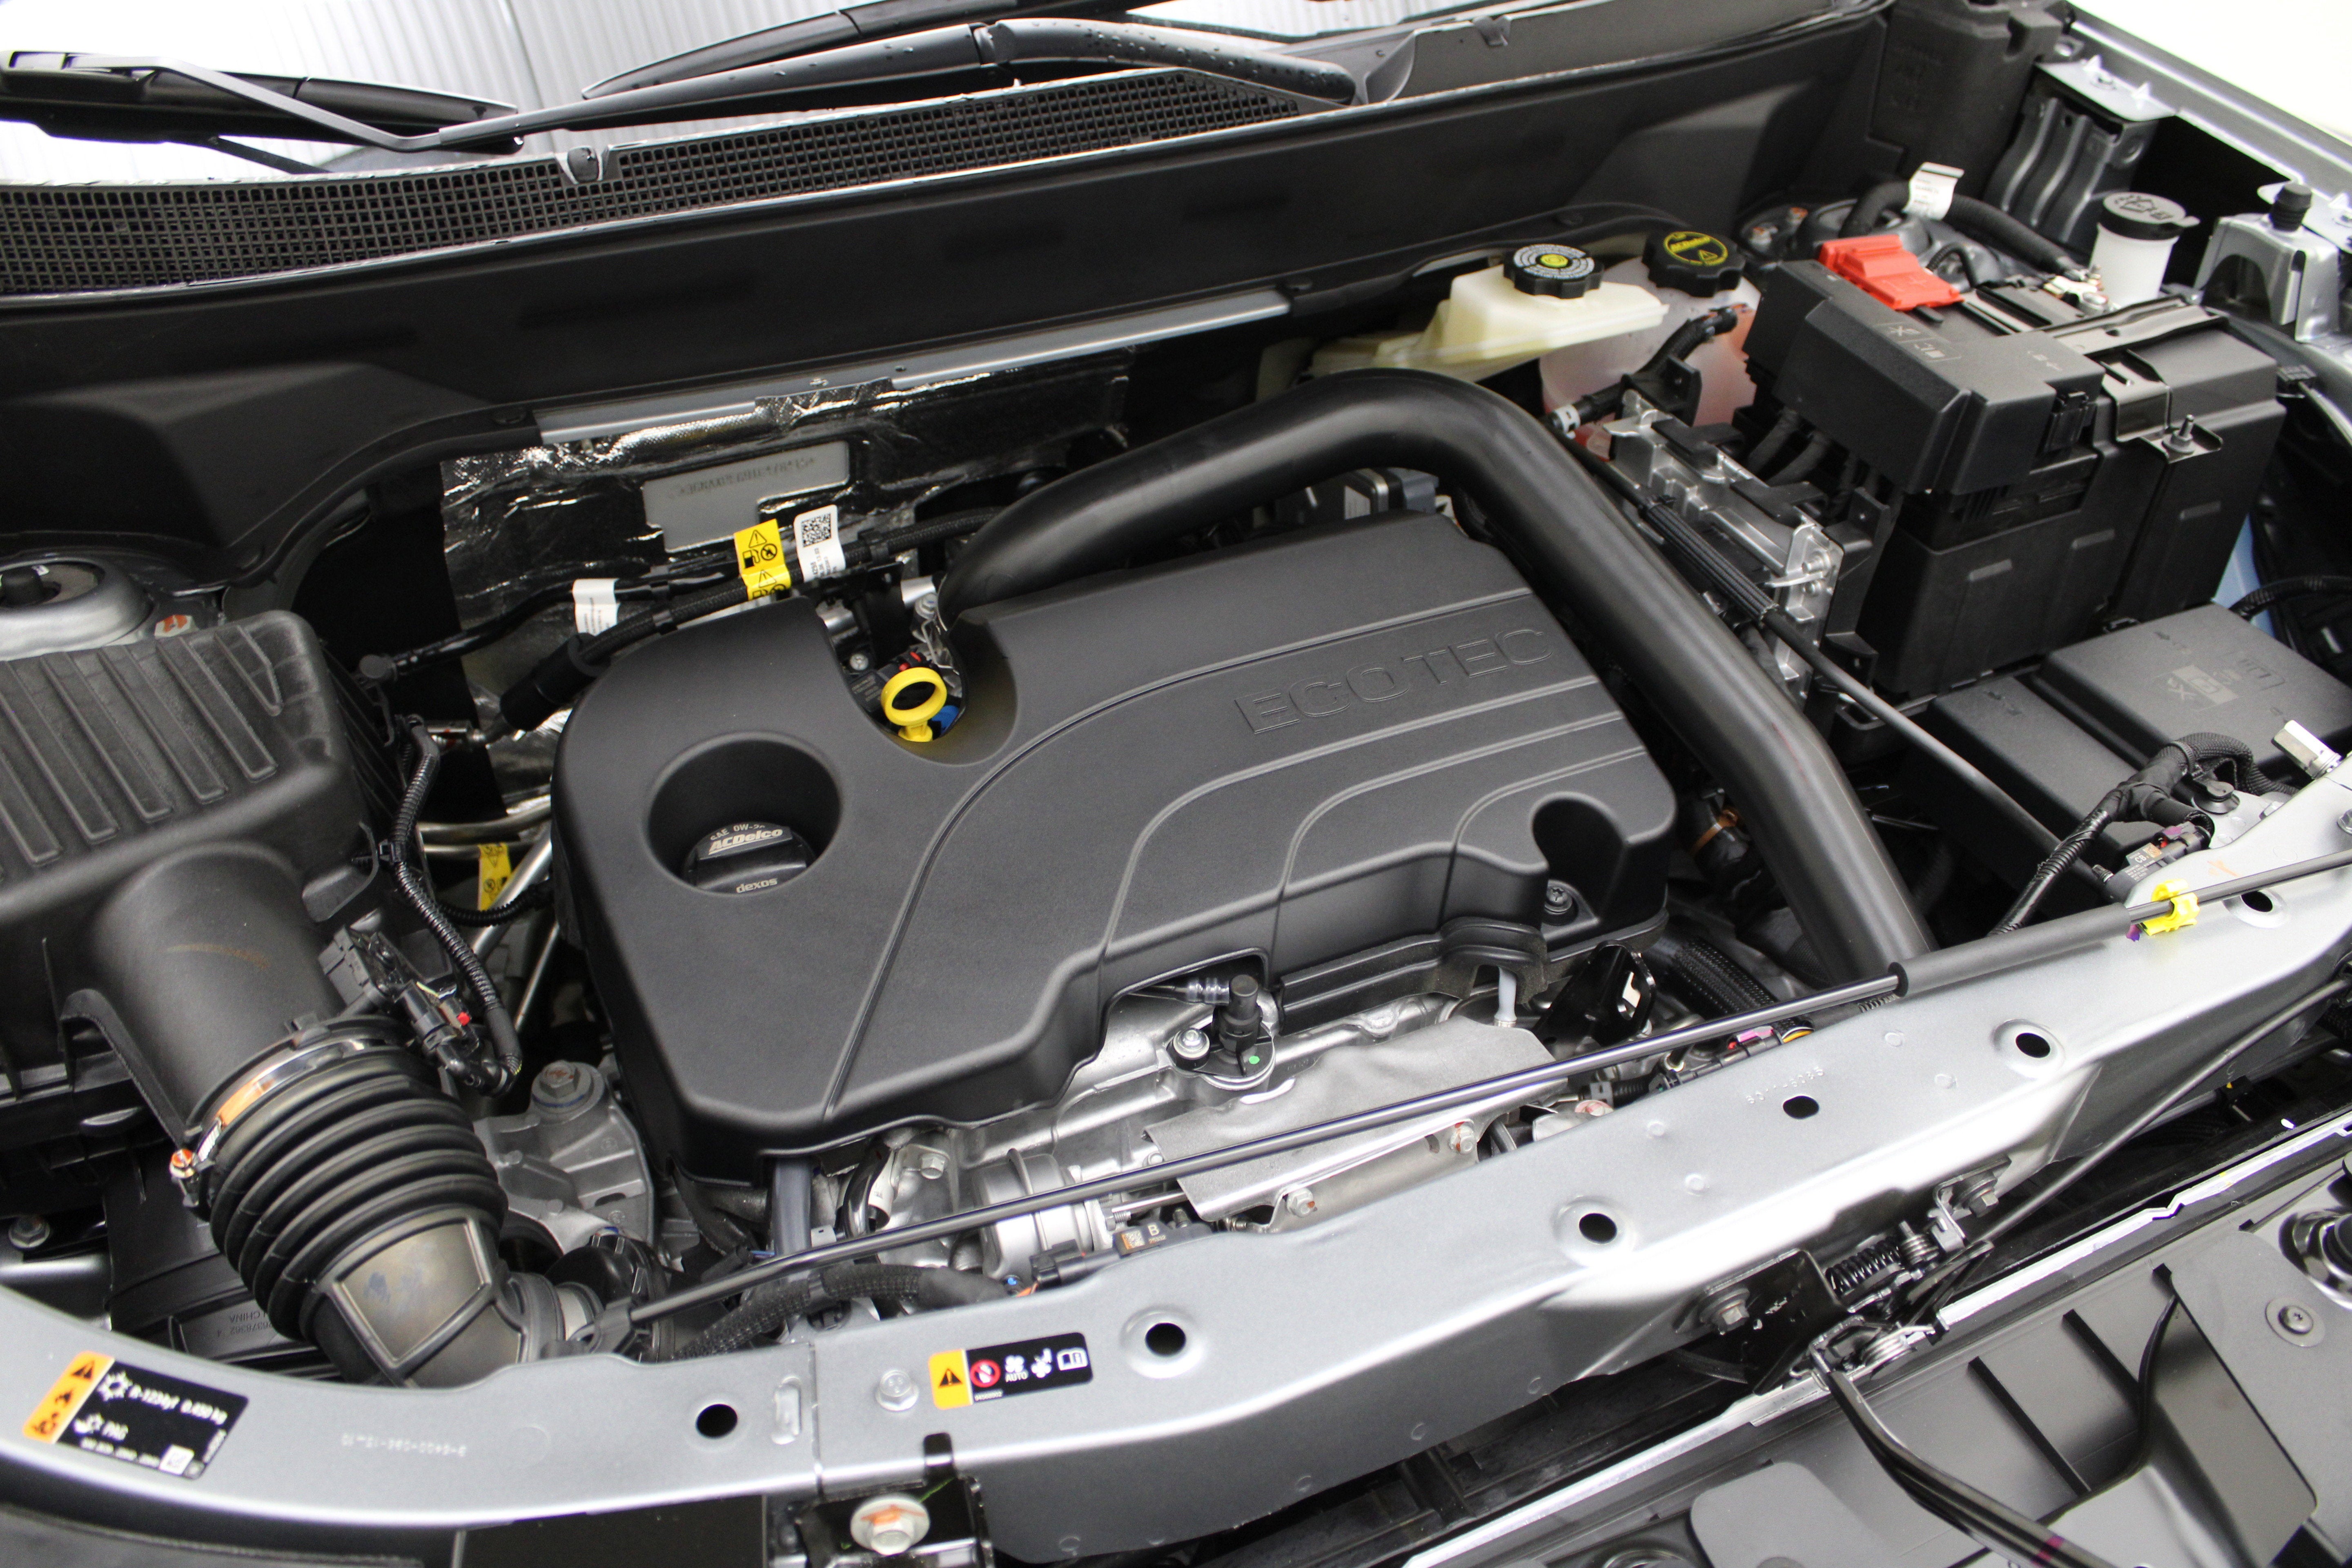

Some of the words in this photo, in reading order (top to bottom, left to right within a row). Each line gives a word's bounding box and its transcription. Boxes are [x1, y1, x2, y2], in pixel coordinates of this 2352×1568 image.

[1234, 628, 1554, 734] ECOTEC
[708, 829, 784, 855] ACDelco
[736, 878, 778, 893] dexos
[1147, 1224, 1160, 1236] B
[229, 1310, 260, 1323] CHINA
[1005, 1369, 1028, 1383] AUTO
